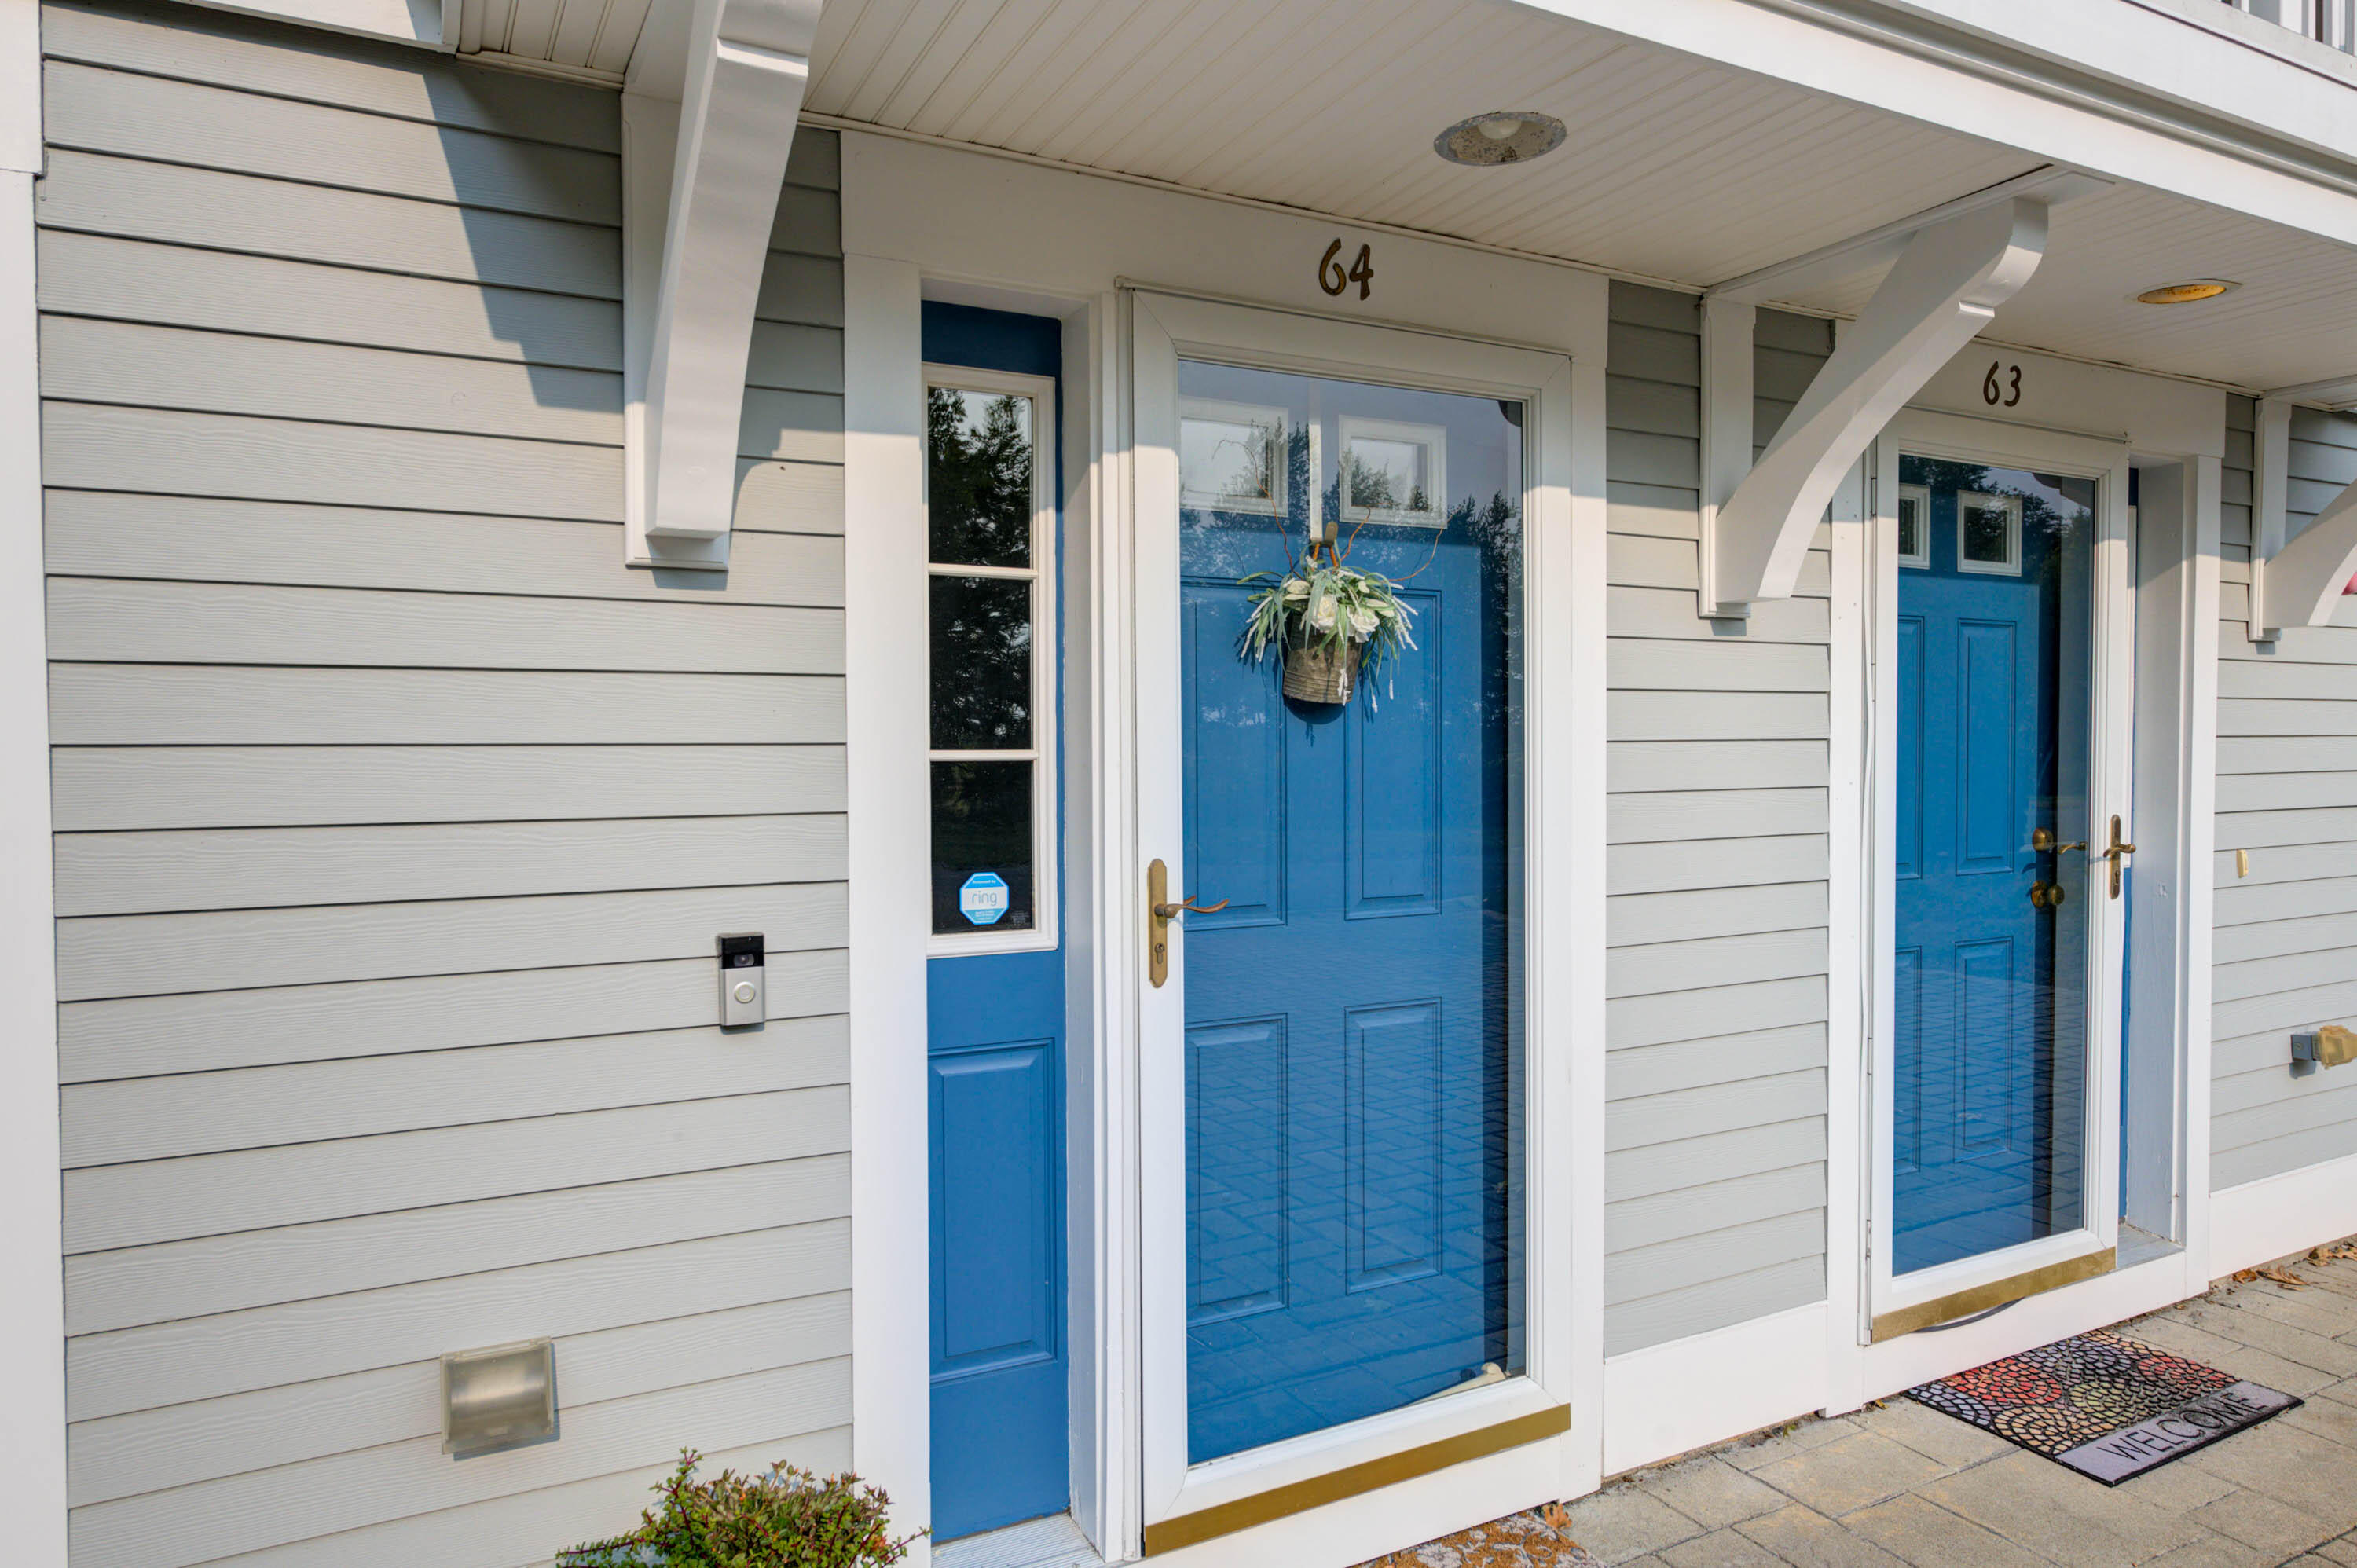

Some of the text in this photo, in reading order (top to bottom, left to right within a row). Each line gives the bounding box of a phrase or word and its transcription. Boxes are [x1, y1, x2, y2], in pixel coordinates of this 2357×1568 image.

[1318, 237, 1374, 301] 64
[1983, 361, 2022, 407] 63
[971, 890, 998, 907] ring
[2096, 1392, 2267, 1462] WELCOME
